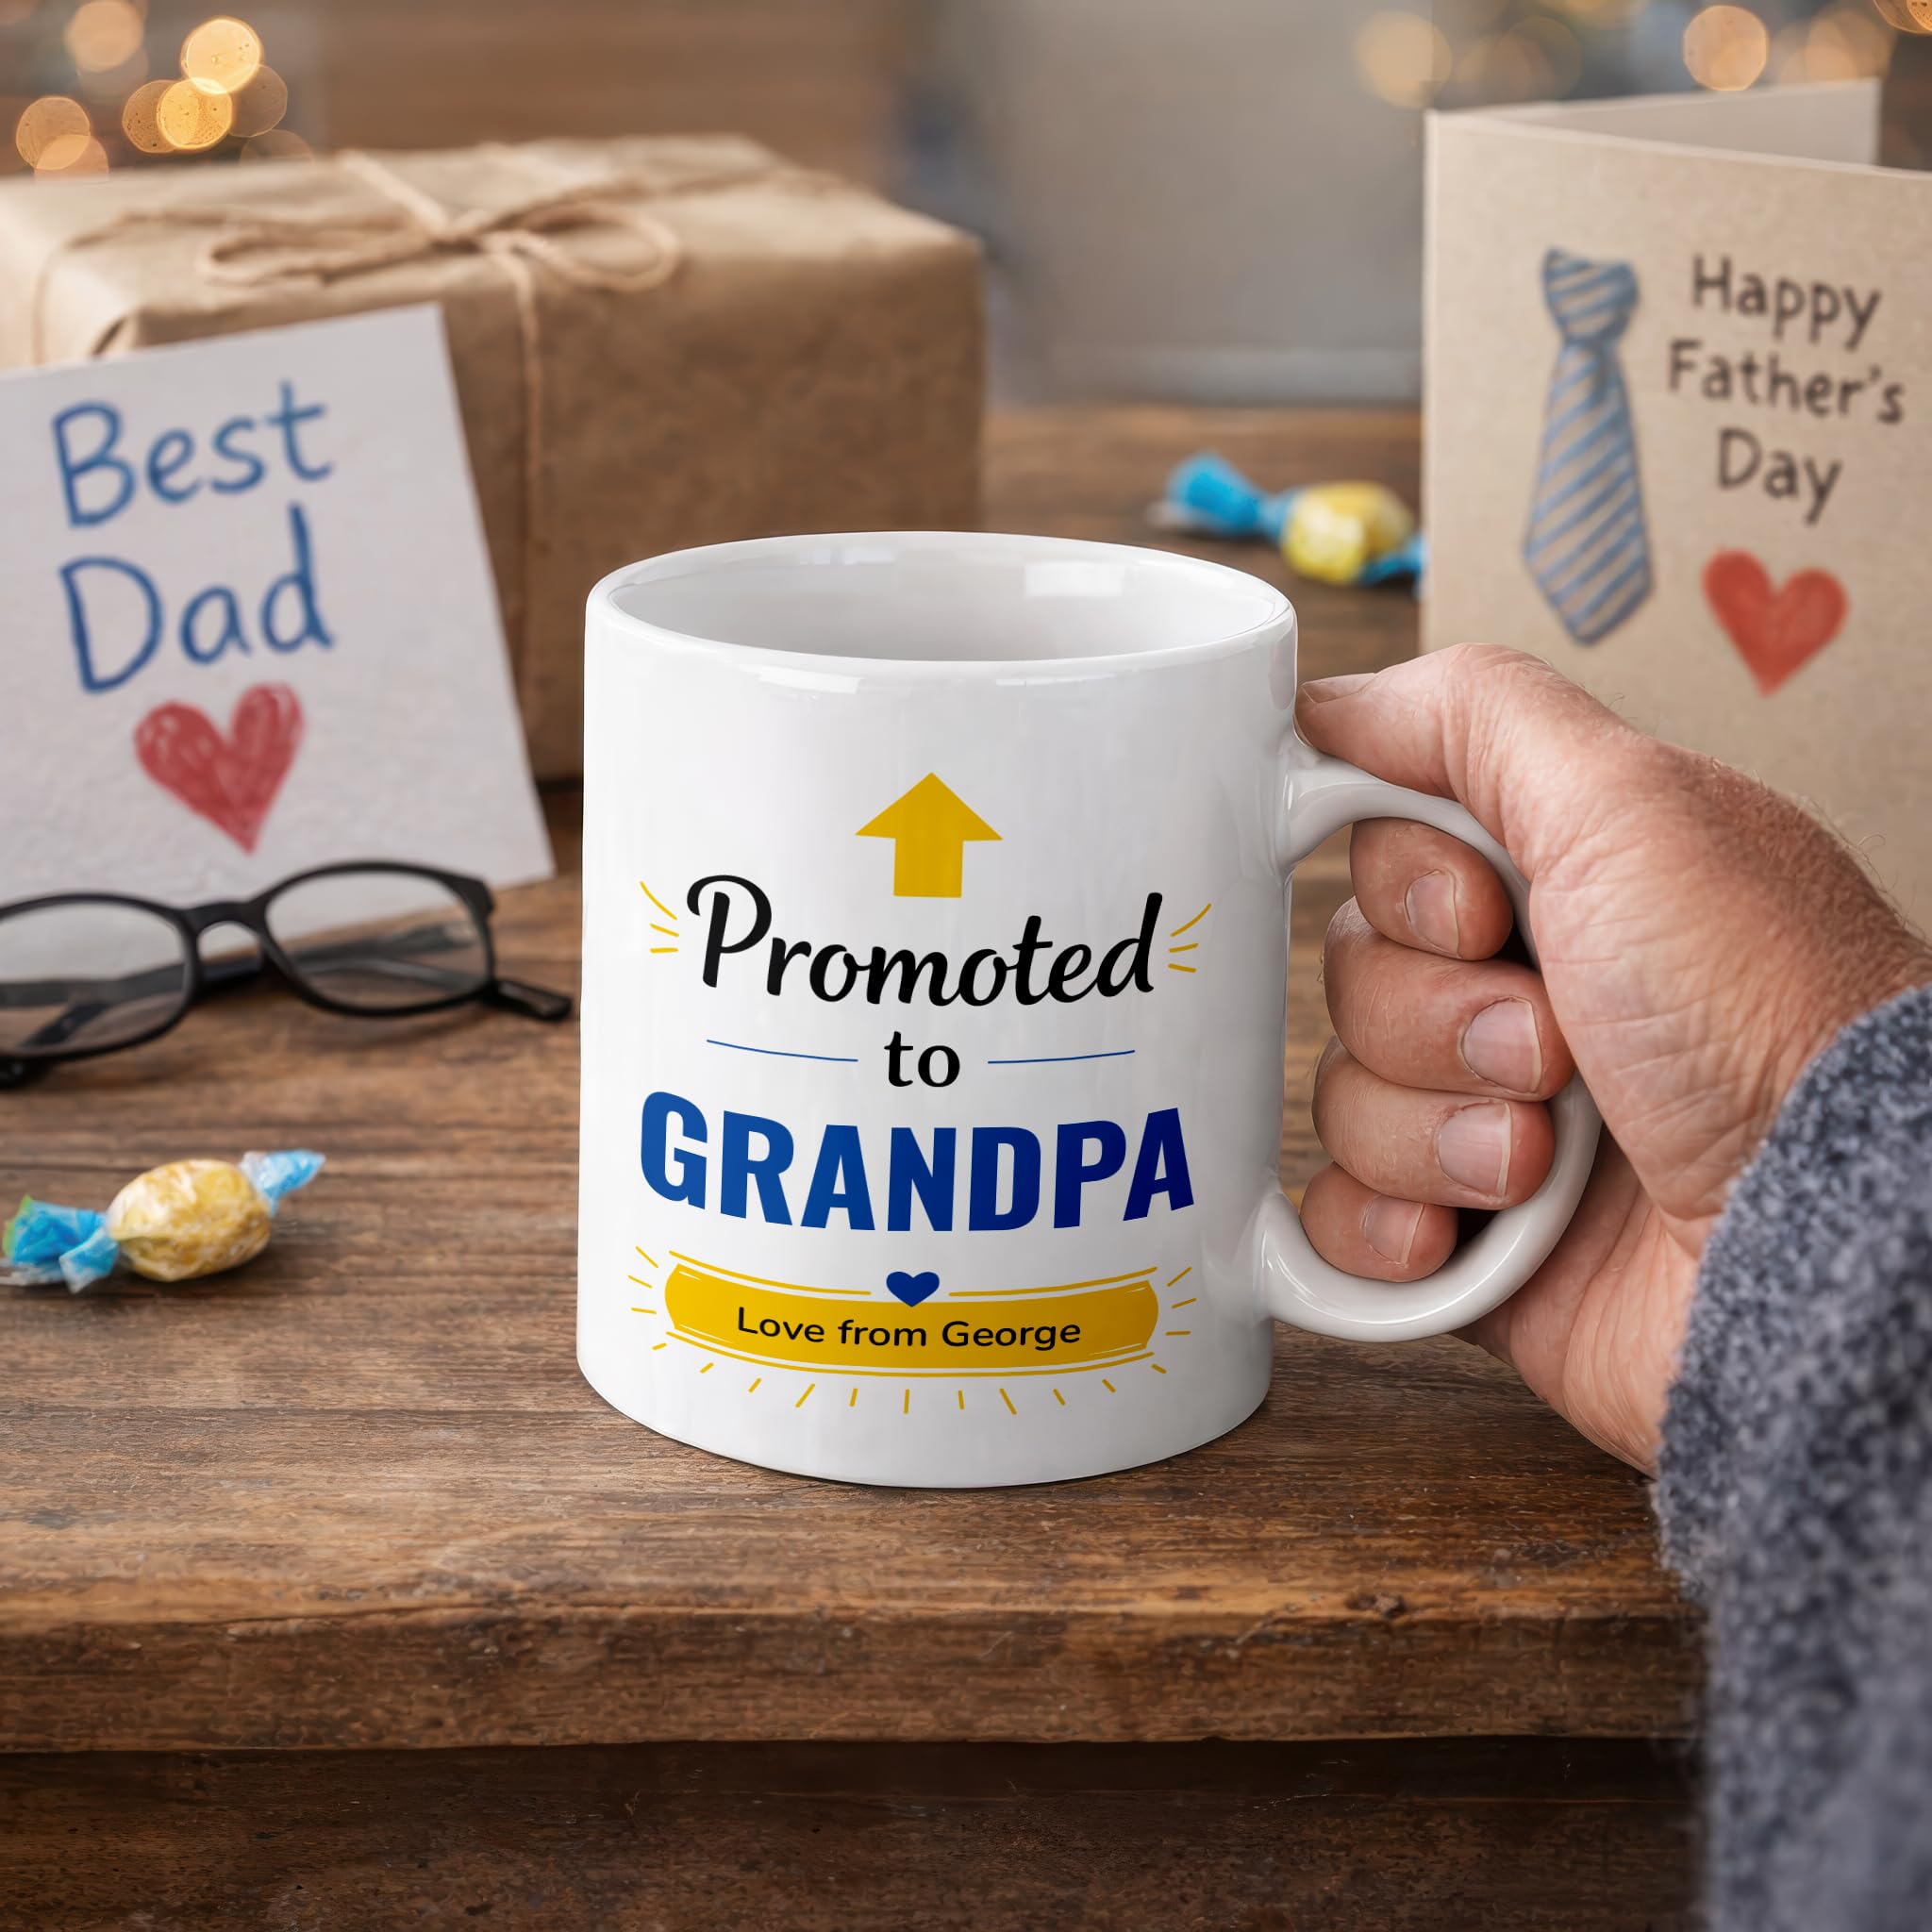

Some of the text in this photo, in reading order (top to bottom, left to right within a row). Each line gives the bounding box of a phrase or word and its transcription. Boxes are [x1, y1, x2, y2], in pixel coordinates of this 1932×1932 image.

[1690, 254, 1882, 351] Happy
[1667, 339, 1905, 425] Father's
[52, 379, 334, 528] Best
[1717, 427, 1841, 525] Day
[58, 501, 334, 694] Dad
[686, 874, 1163, 1007] Promoted
[884, 1031, 960, 1088] to
[640, 1091, 1194, 1232] GRANDPA
[736, 1307, 1082, 1352] Love from George
